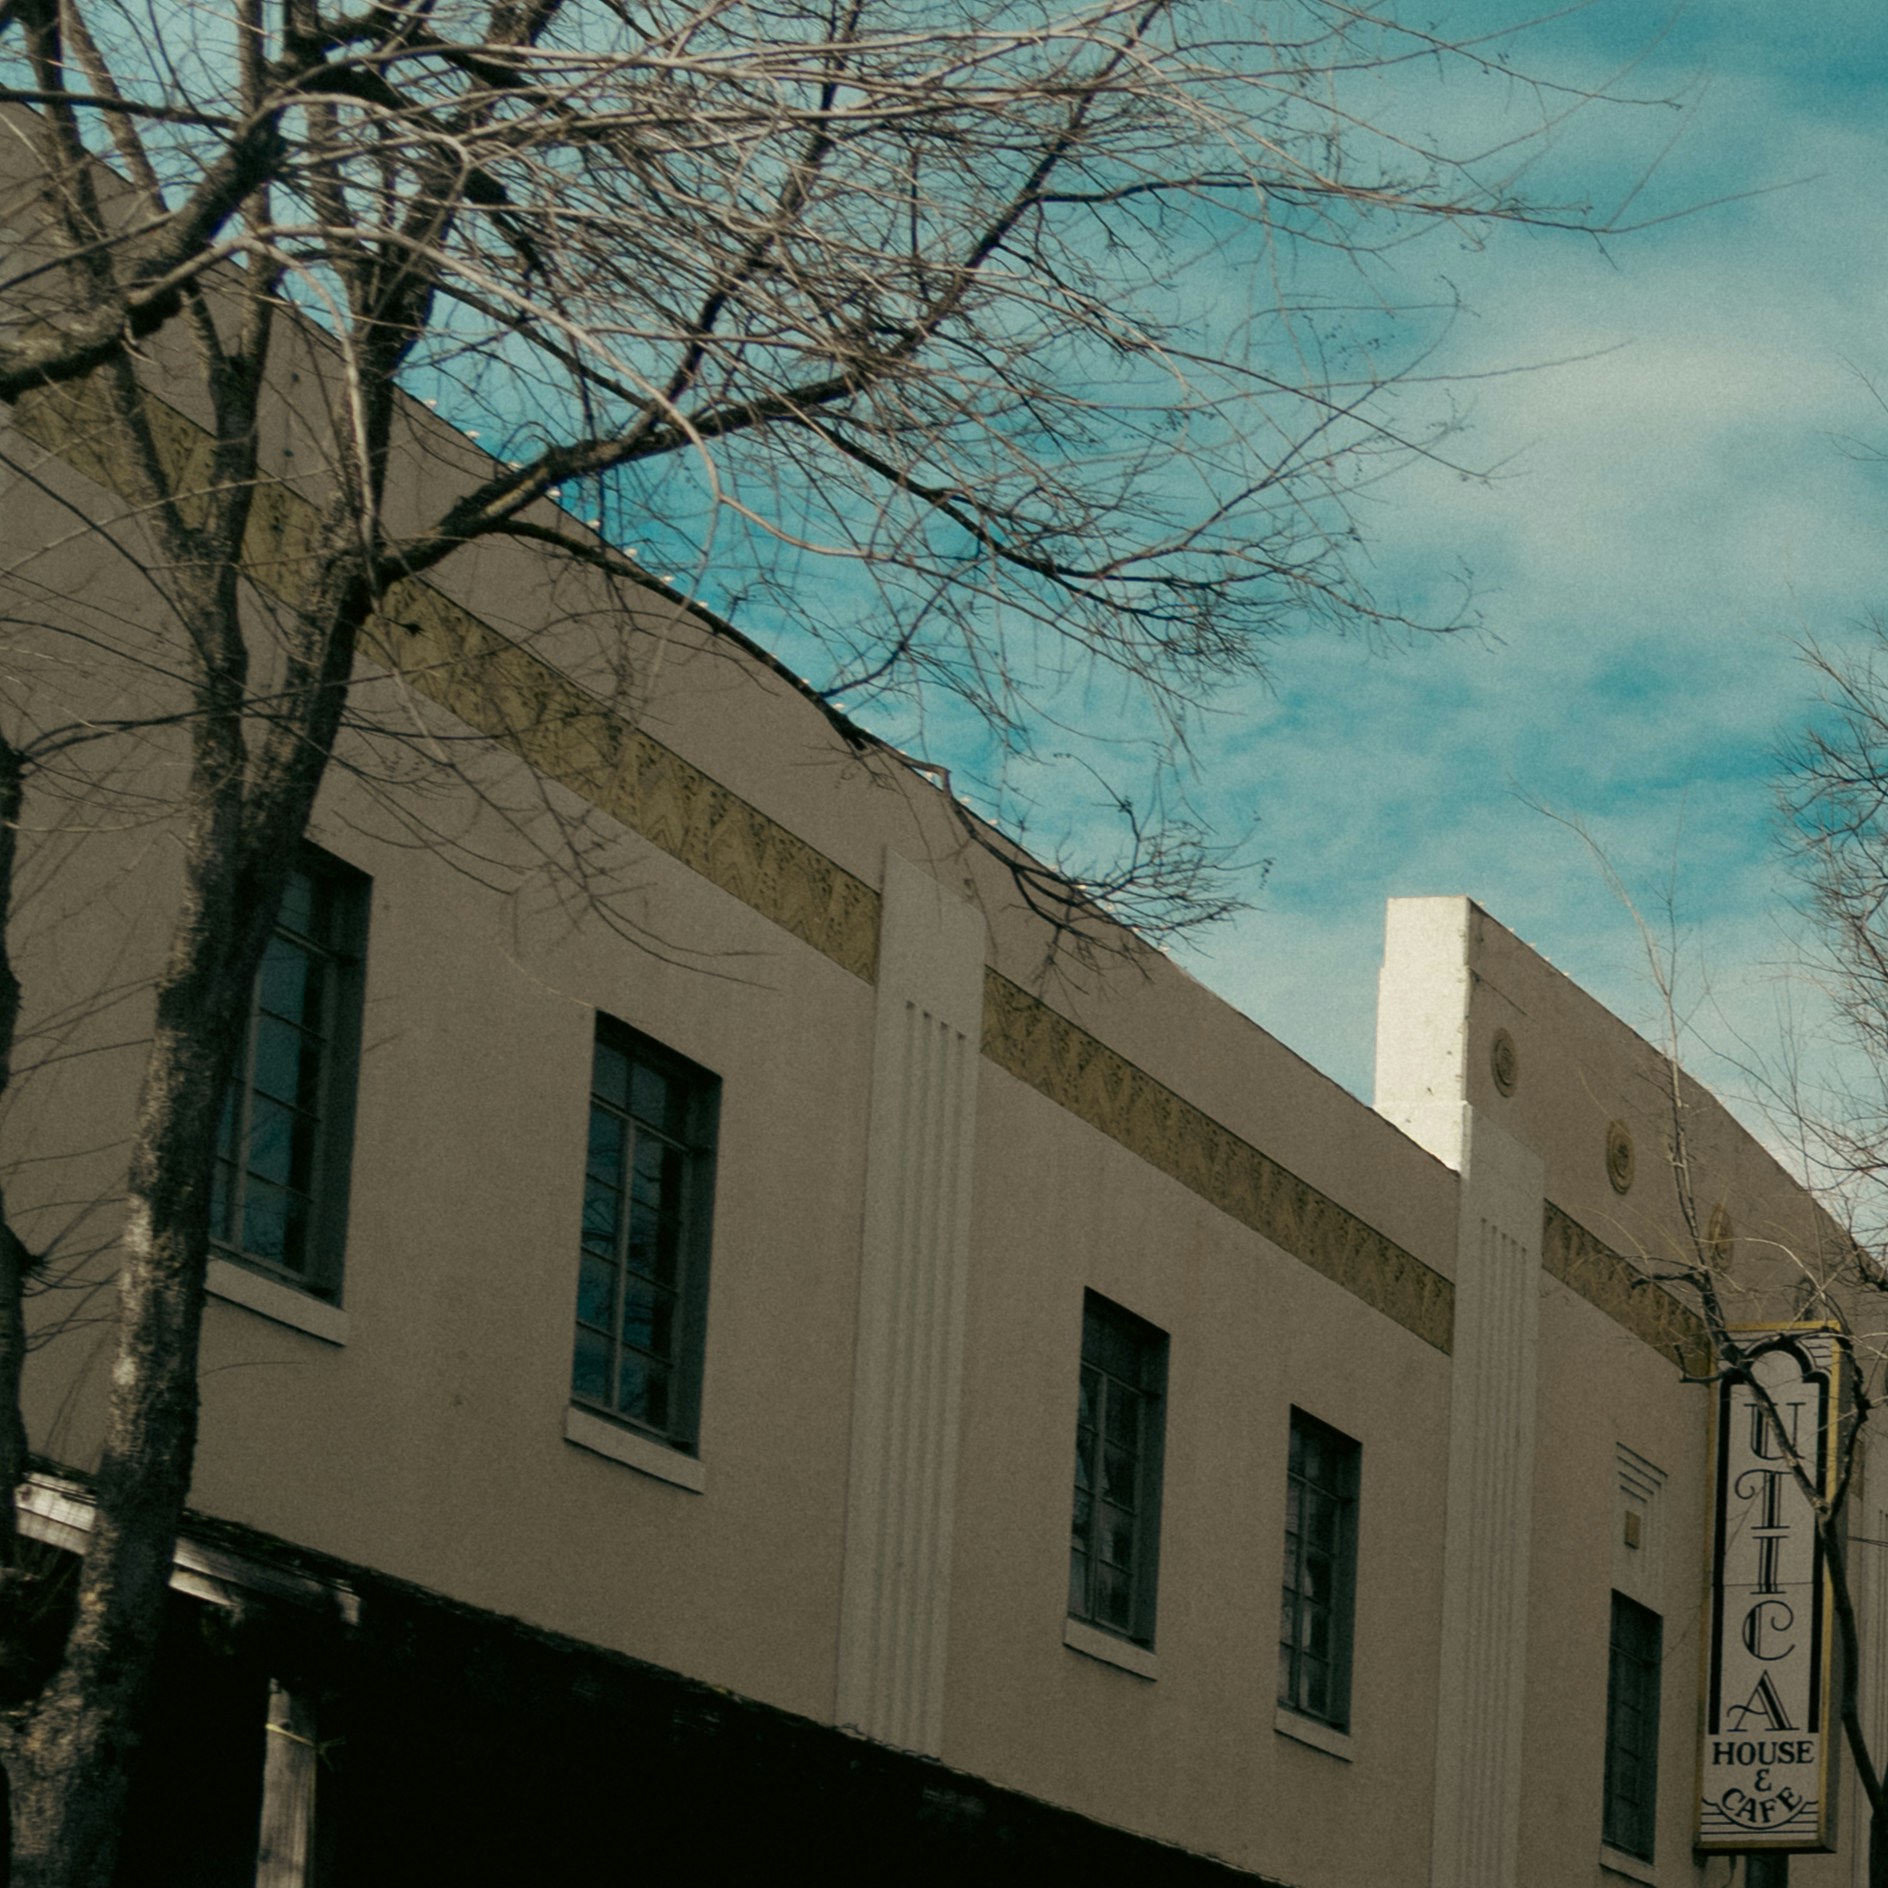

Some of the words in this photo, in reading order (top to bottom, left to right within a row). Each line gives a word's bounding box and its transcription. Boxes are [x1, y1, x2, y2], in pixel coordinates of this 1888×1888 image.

[1726, 1402, 1806, 1732] UTICA
[1711, 1739, 1814, 1766] HOUSE
[1720, 1784, 1803, 1824] CAFE
